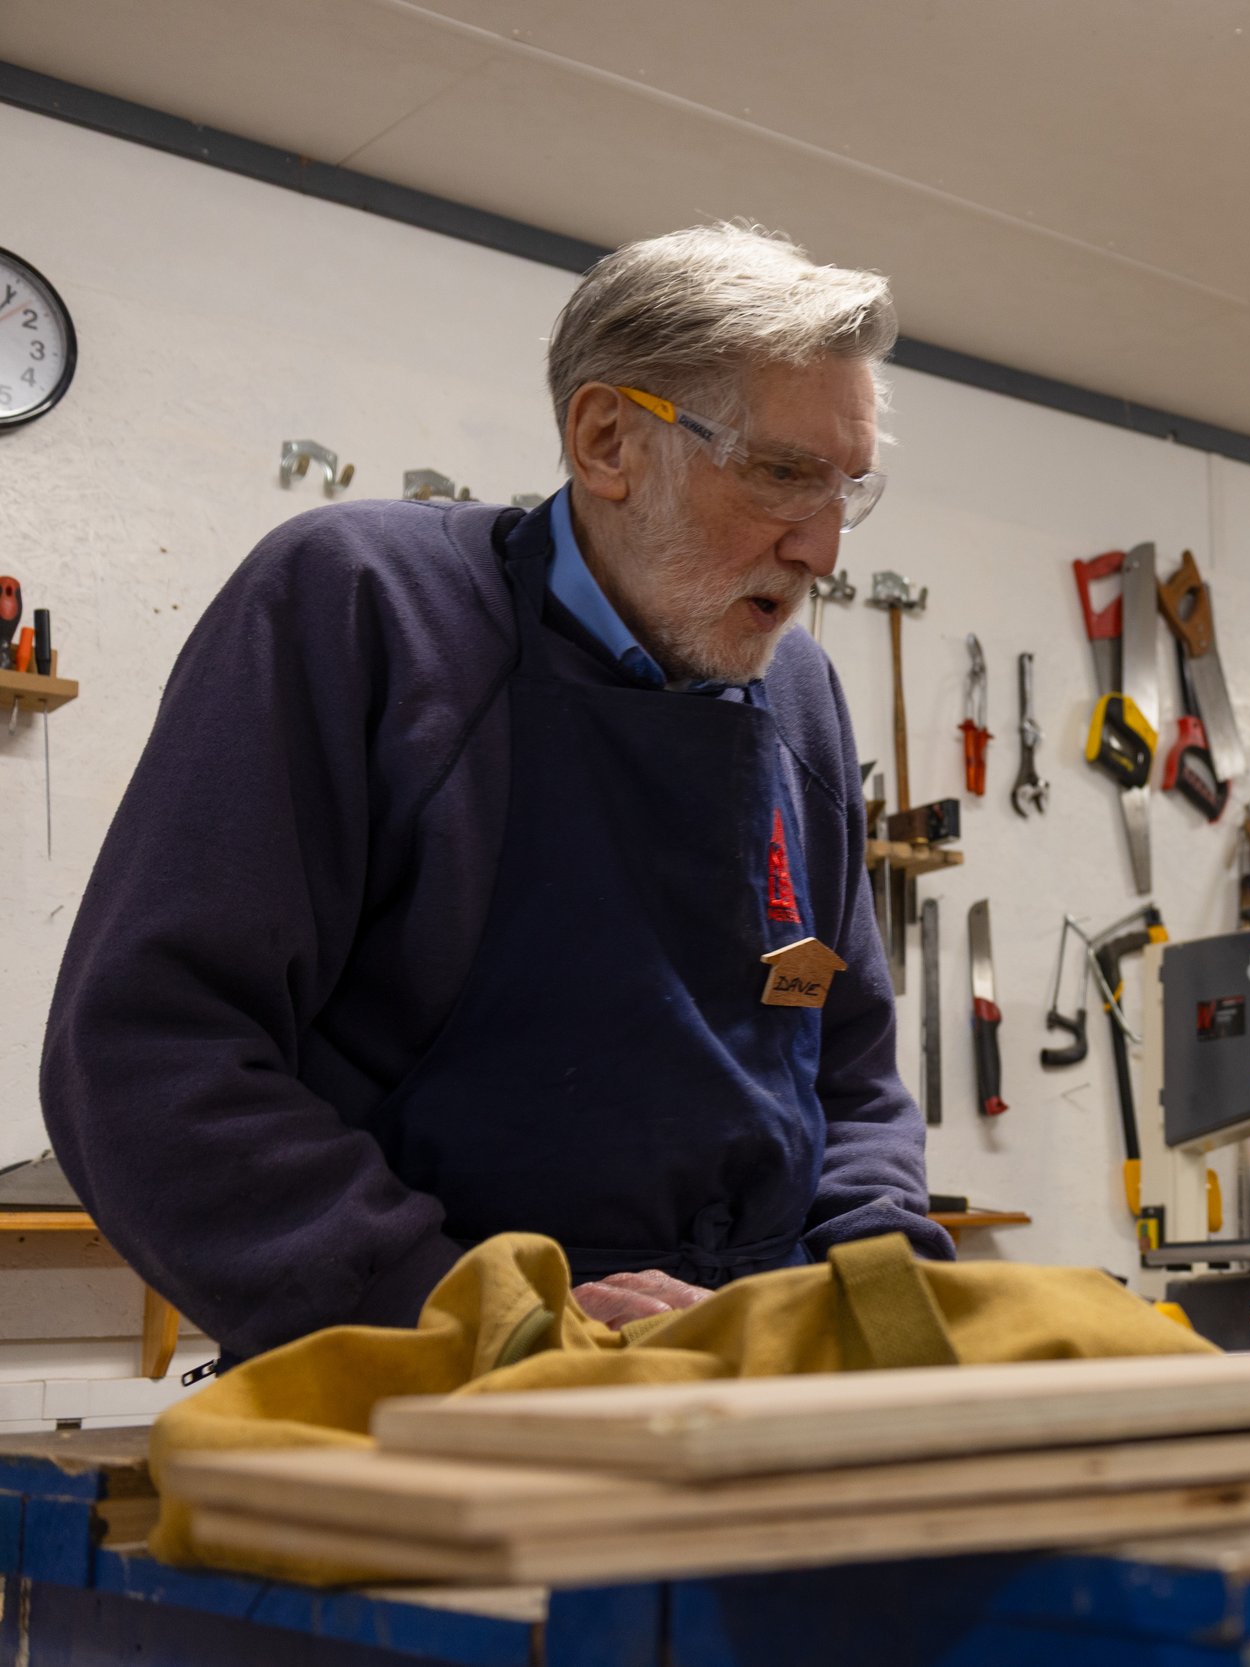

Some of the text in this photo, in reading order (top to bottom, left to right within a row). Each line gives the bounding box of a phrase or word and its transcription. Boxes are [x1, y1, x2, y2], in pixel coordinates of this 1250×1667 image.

[22, 309, 38, 330] 2
[30, 340, 45, 361] 3
[20, 367, 36, 387] 4
[773, 976, 821, 996] DAVE
